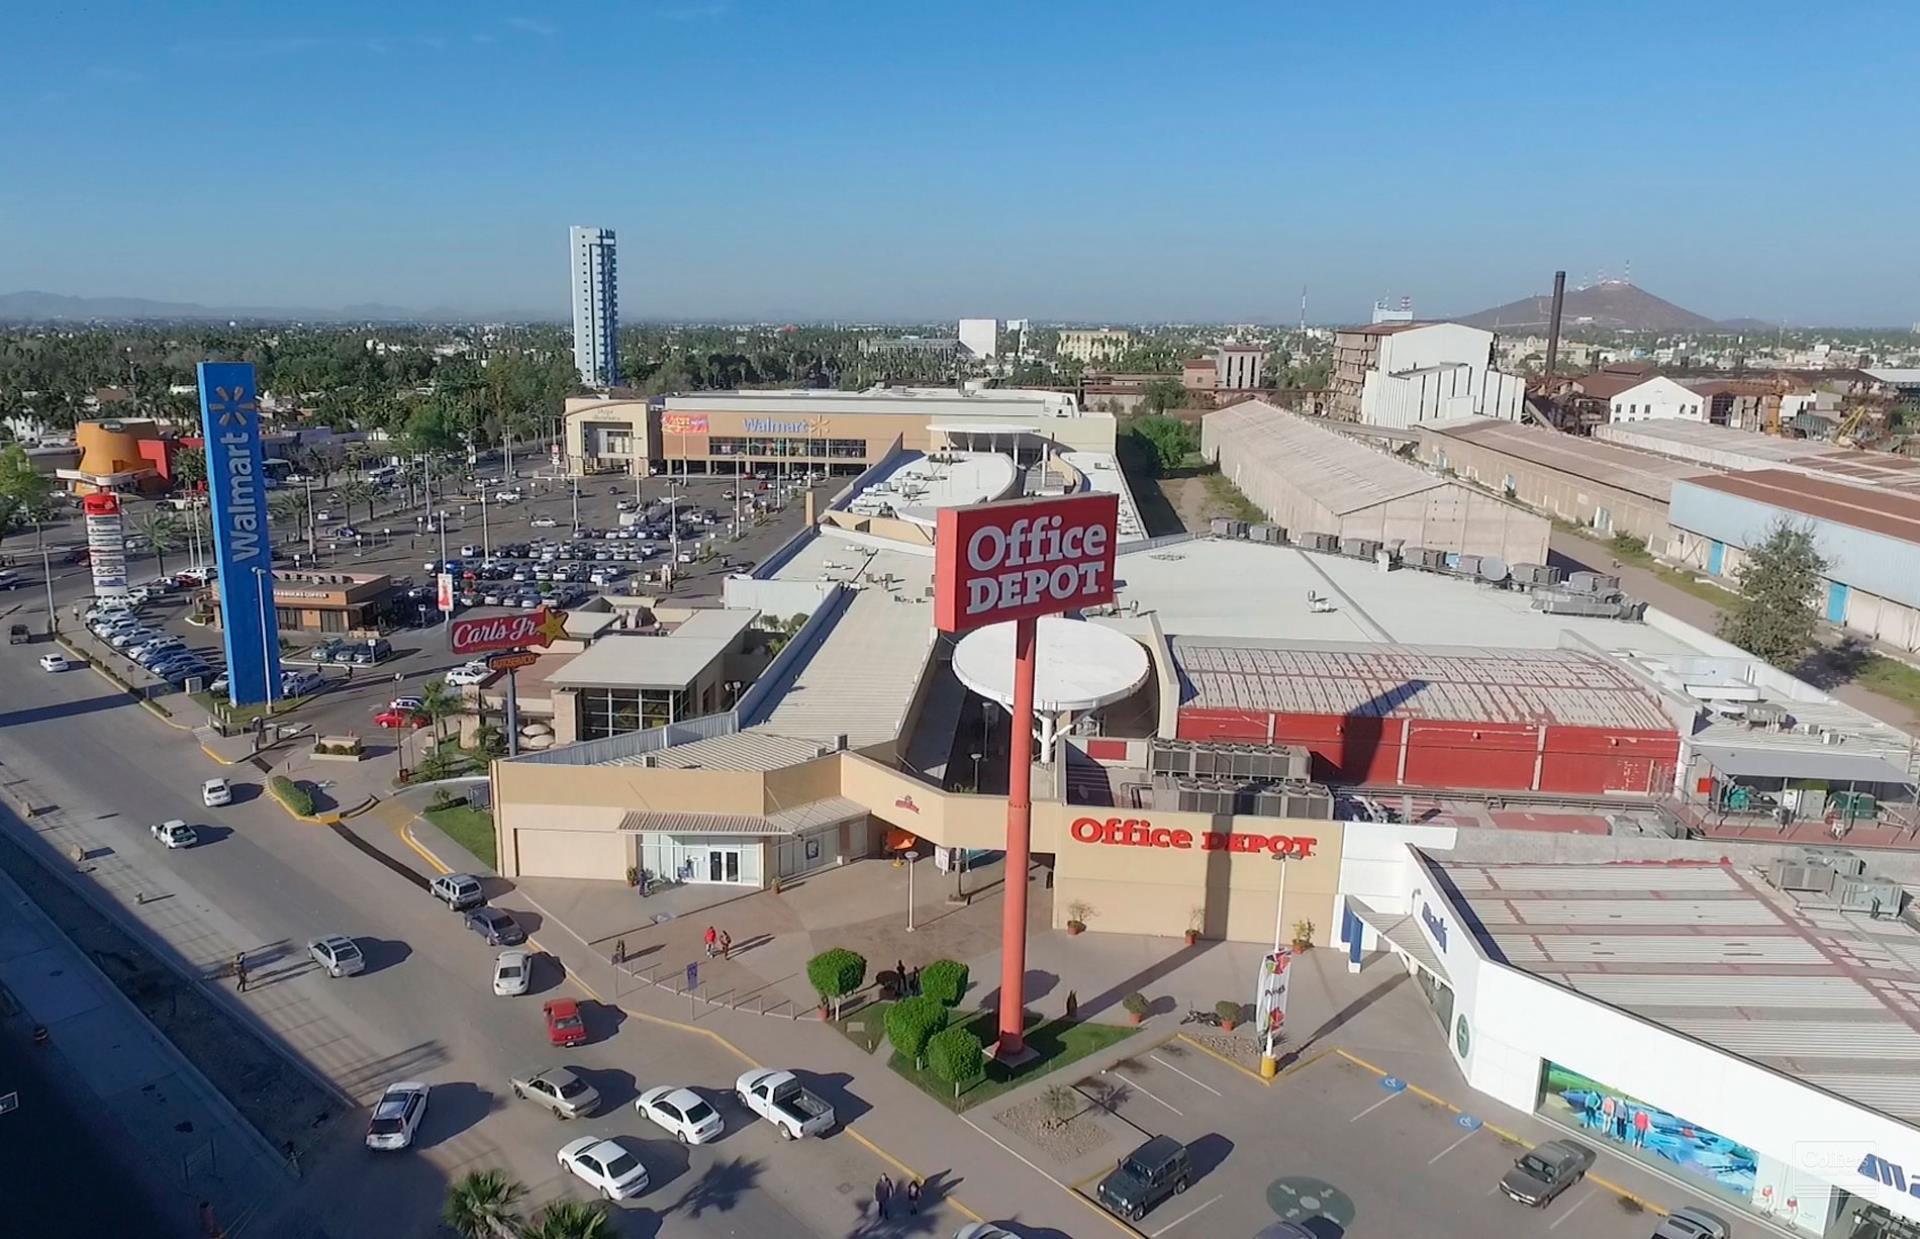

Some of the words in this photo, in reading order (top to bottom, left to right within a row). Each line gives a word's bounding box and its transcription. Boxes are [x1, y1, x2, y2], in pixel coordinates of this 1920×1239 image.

[743, 416, 809, 433] Walmart
[220, 432, 260, 562] Walmart
[967, 515, 1107, 571] Office
[453, 619, 508, 648] Carl's
[1071, 816, 1194, 849] Office
[1201, 831, 1317, 857] DEPOT
